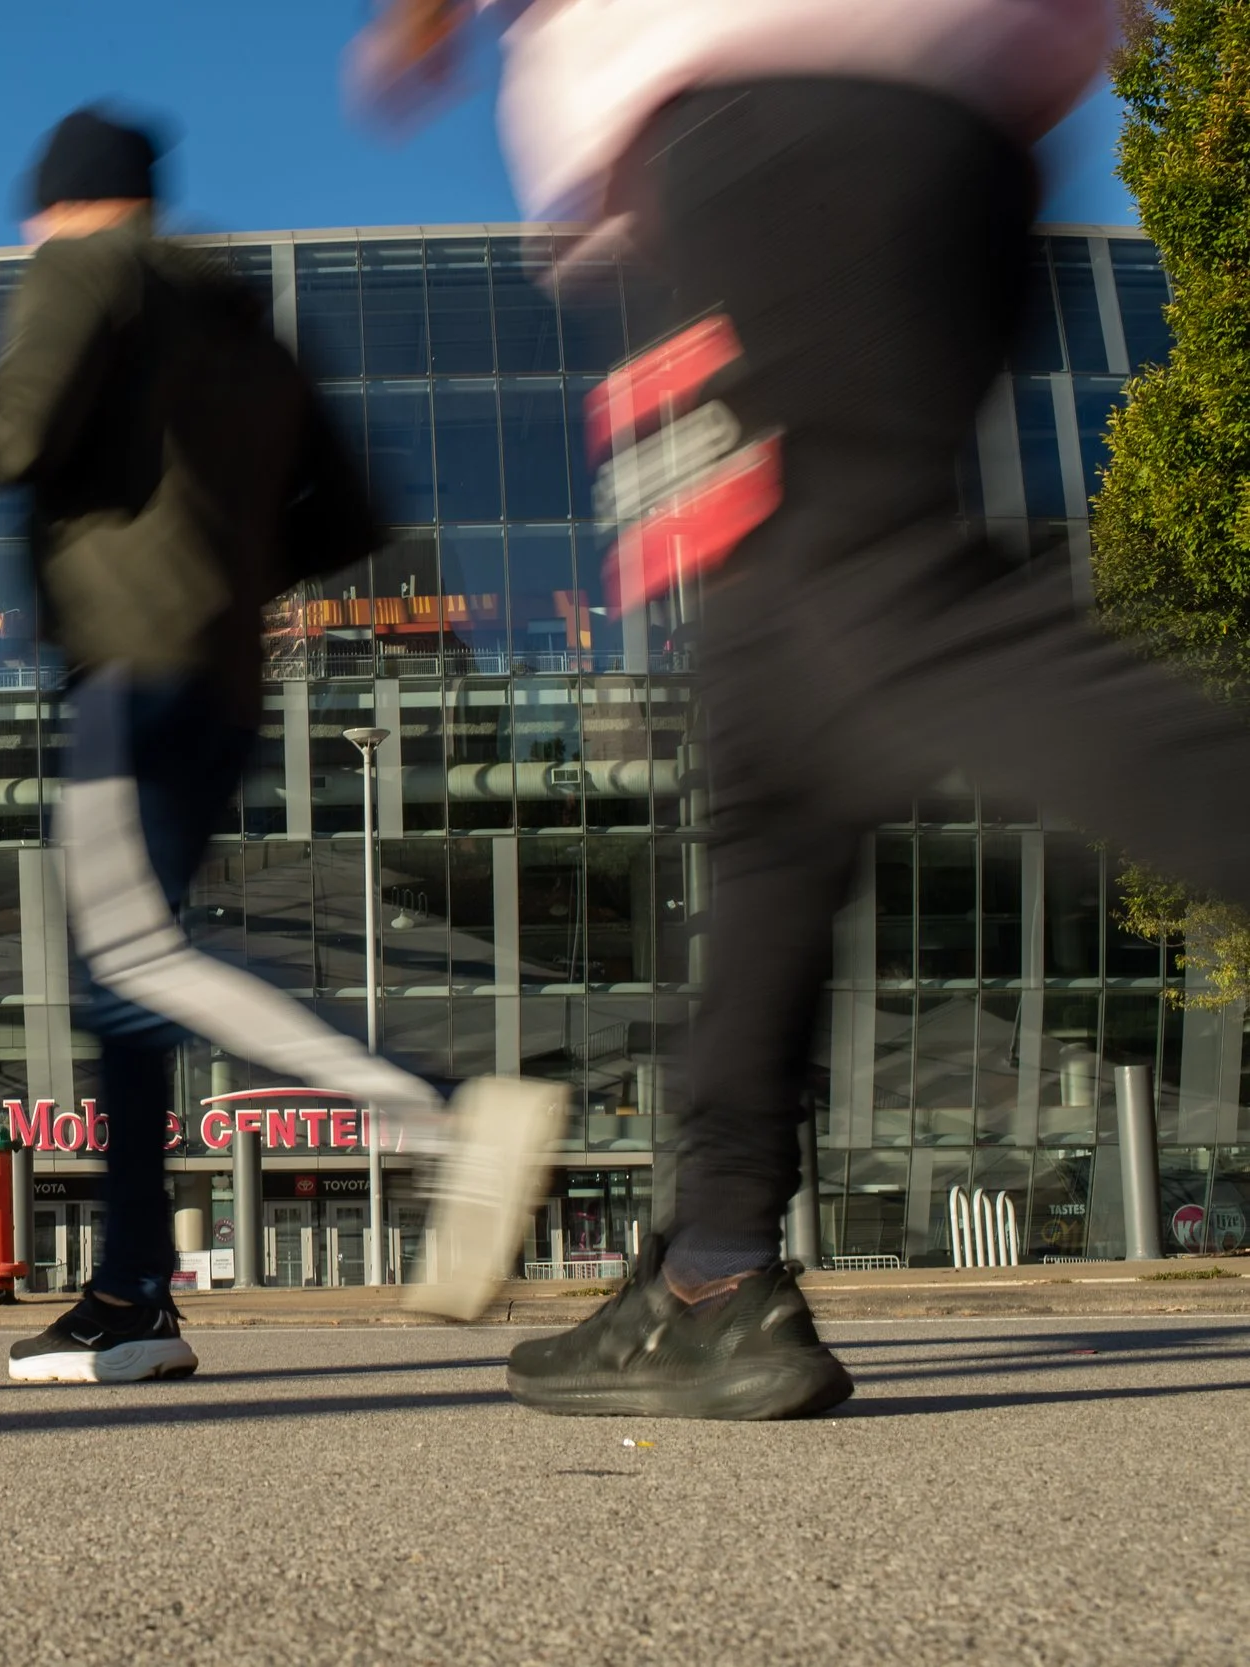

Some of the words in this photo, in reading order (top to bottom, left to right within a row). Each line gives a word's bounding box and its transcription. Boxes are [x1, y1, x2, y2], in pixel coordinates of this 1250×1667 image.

[2, 1098, 182, 1153] Mobe
[34, 1183, 67, 1194] YOTA
[1049, 1203, 1086, 1216] TASTES
